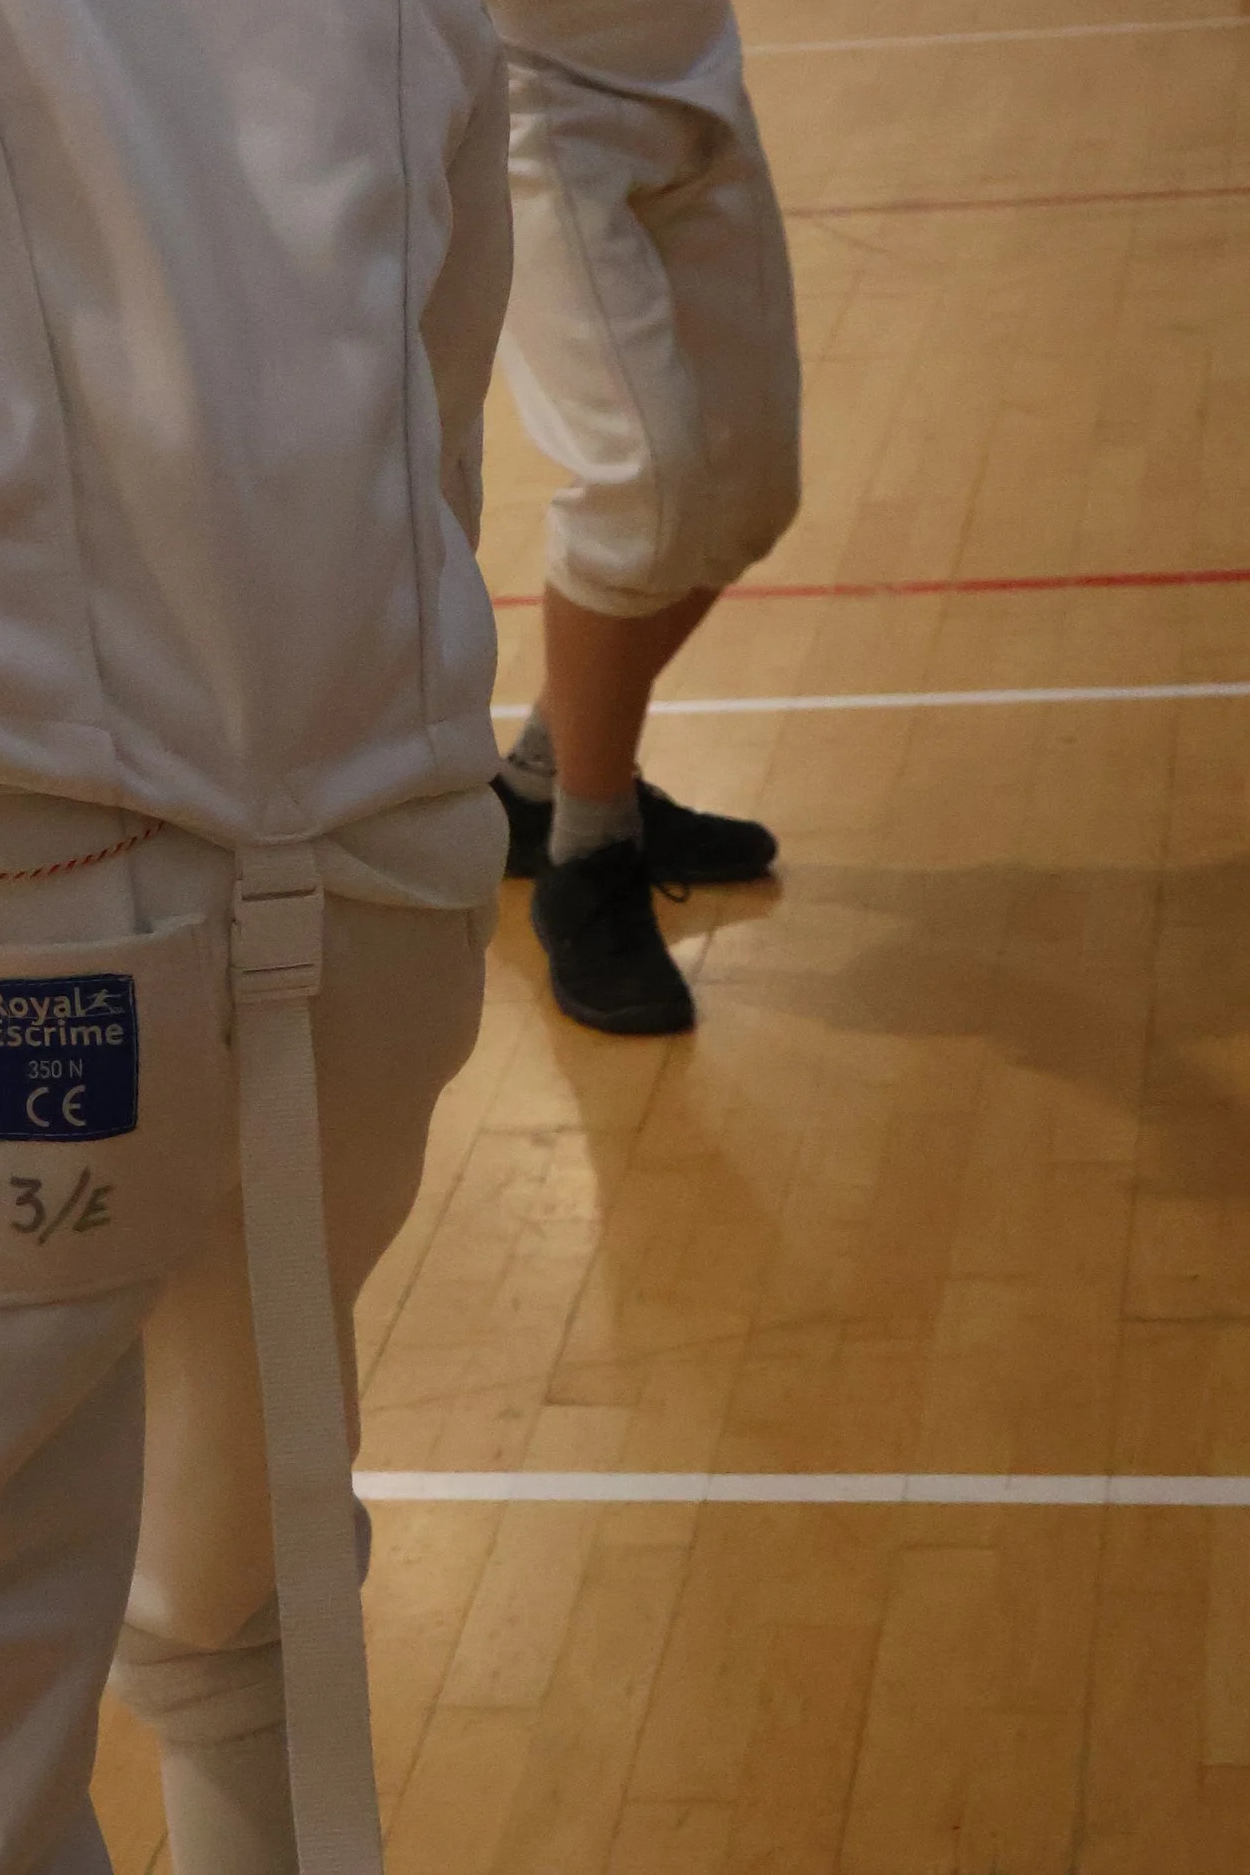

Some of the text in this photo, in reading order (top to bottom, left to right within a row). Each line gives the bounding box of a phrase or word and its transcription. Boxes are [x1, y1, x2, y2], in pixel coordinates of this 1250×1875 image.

[28, 1059, 84, 1079] 350 N
[25, 1084, 88, 1127] CE
